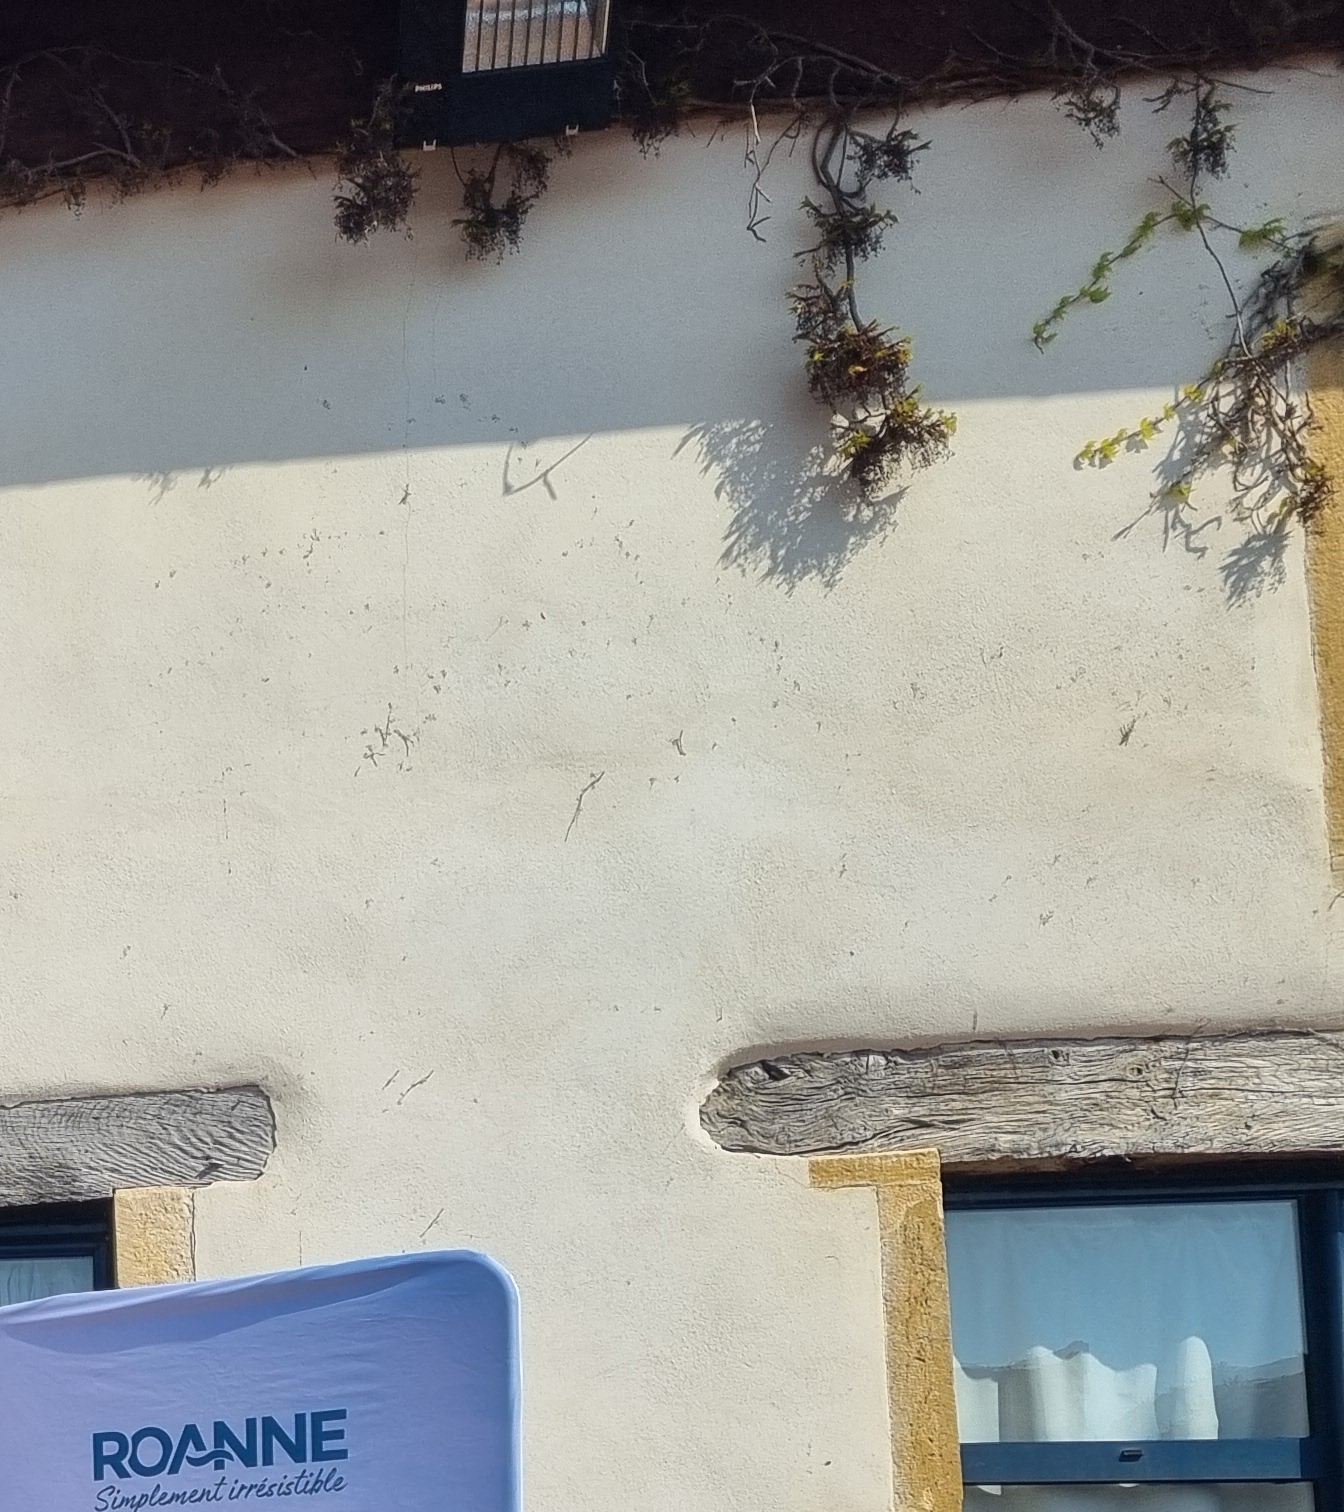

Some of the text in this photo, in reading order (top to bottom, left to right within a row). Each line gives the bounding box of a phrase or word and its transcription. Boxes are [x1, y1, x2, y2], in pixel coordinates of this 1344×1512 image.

[415, 83, 442, 92] PHILIPS
[92, 1409, 348, 1481] ROANNE
[228, 1467, 348, 1501] irrésistible
